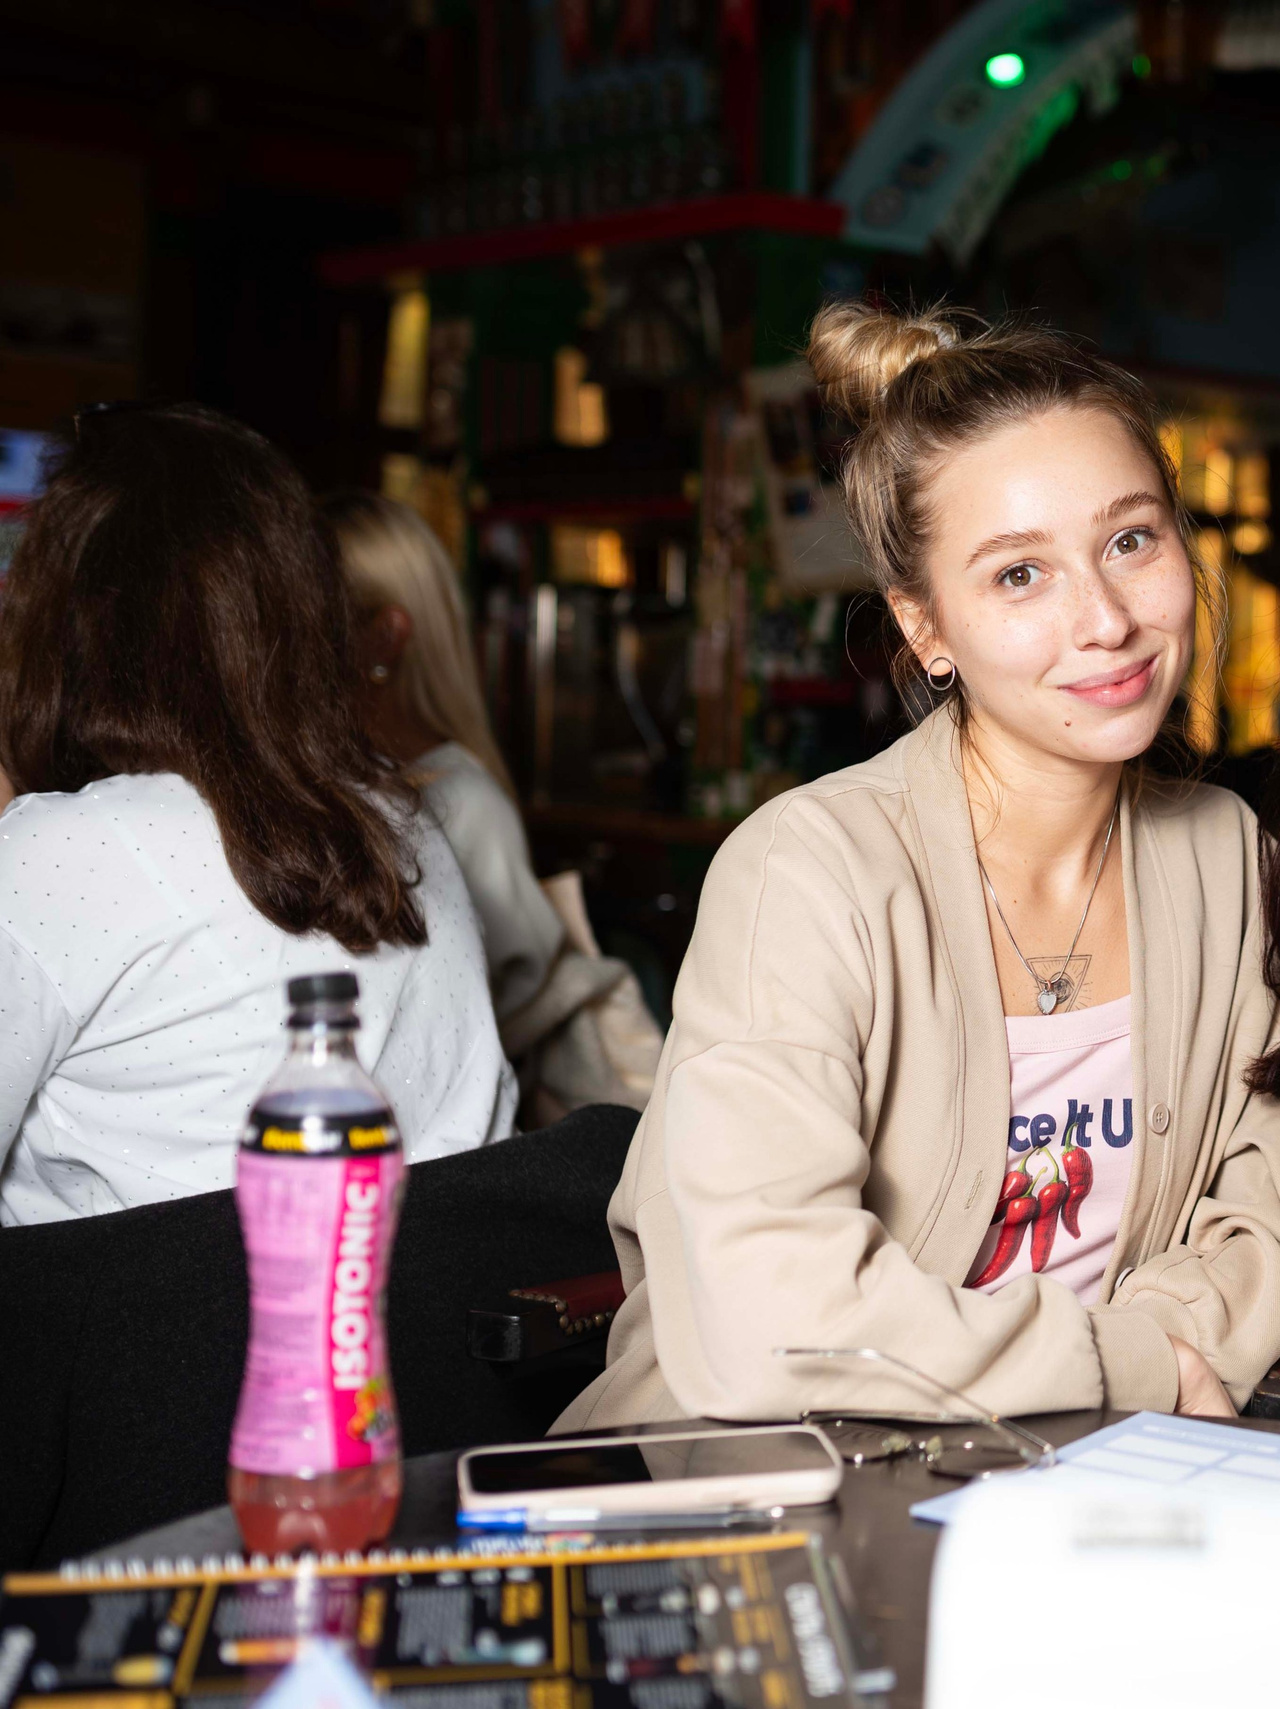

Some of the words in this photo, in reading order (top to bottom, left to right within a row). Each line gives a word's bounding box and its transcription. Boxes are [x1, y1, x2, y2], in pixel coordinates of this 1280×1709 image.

[1008, 1113, 1057, 1153] ce
[1061, 1099, 1094, 1148] It
[1101, 1098, 1134, 1149] U
[331, 1182, 380, 1390] ISOTONIC
